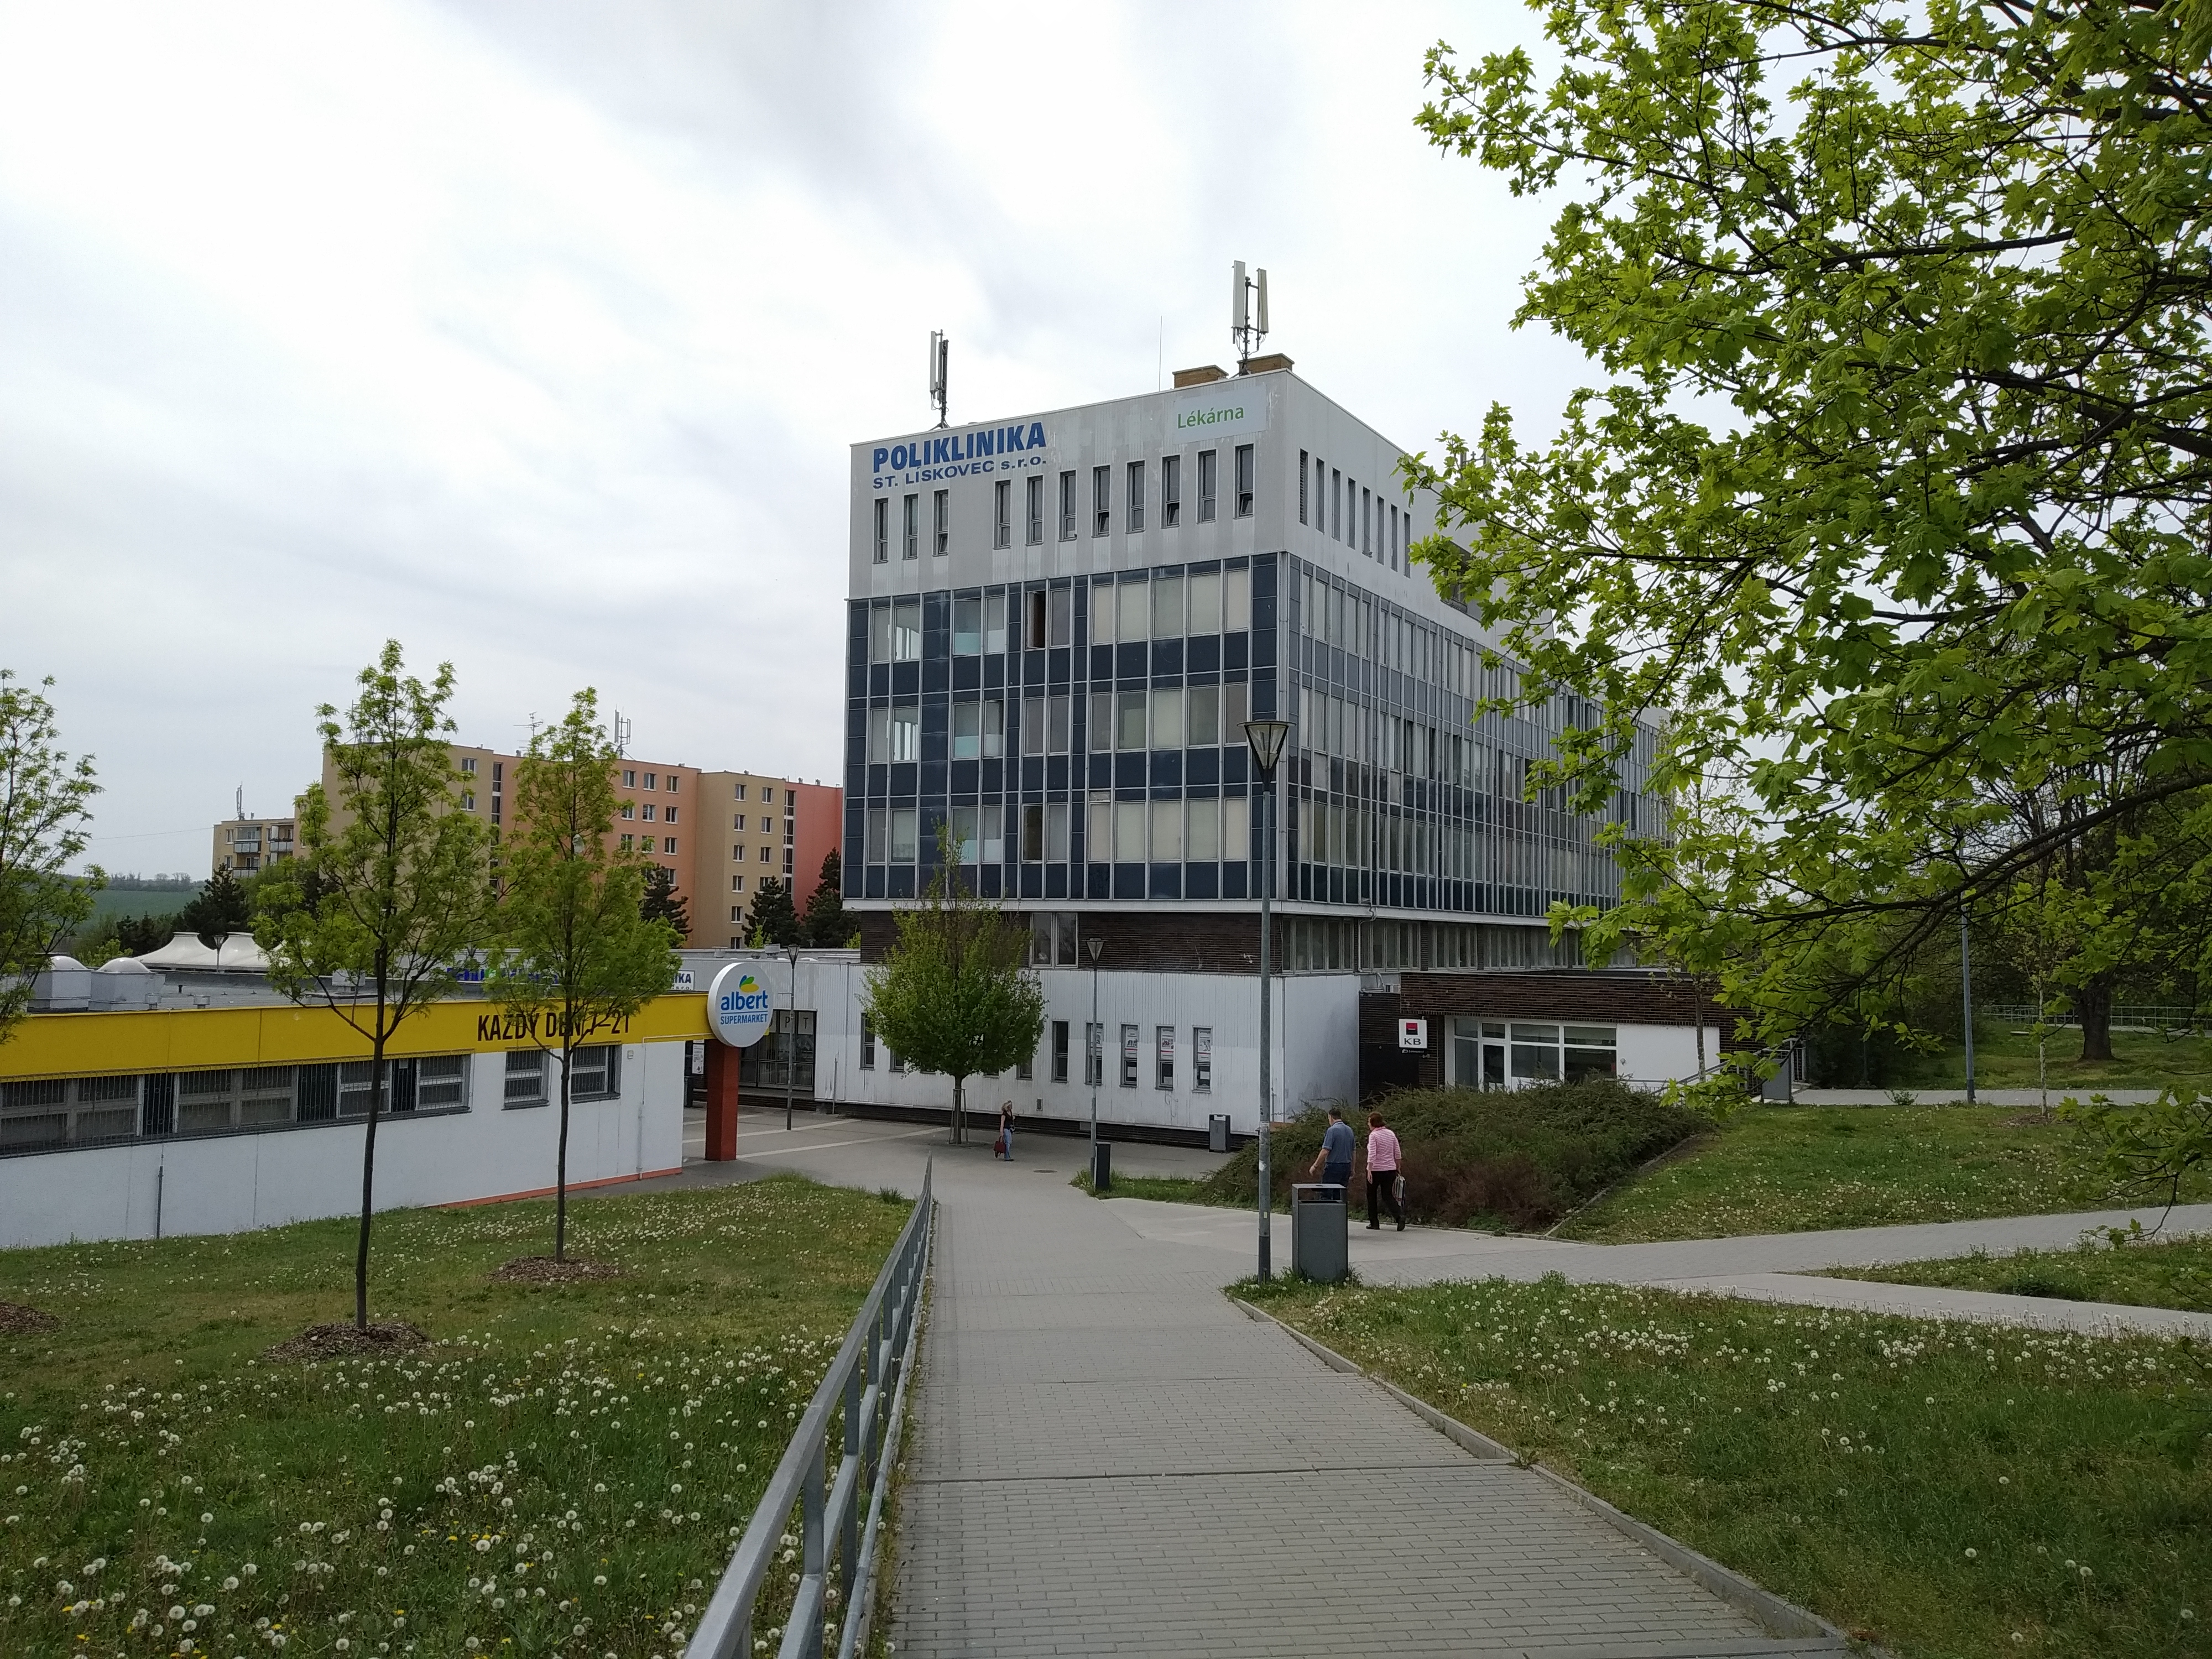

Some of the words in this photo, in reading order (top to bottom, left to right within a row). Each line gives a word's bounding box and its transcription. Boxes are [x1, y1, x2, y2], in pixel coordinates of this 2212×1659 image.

[1178, 407, 1244, 429] Lékárna
[873, 422, 1046, 473] POLIKLINIKA
[873, 476, 898, 489] ST.
[905, 460, 994, 485] LÍSKOVEC
[1001, 457, 1046, 470] s.r.o.
[721, 990, 768, 1011] albert
[545, 1011, 581, 1037] DEN
[721, 1013, 768, 1025] SUPERMARKET
